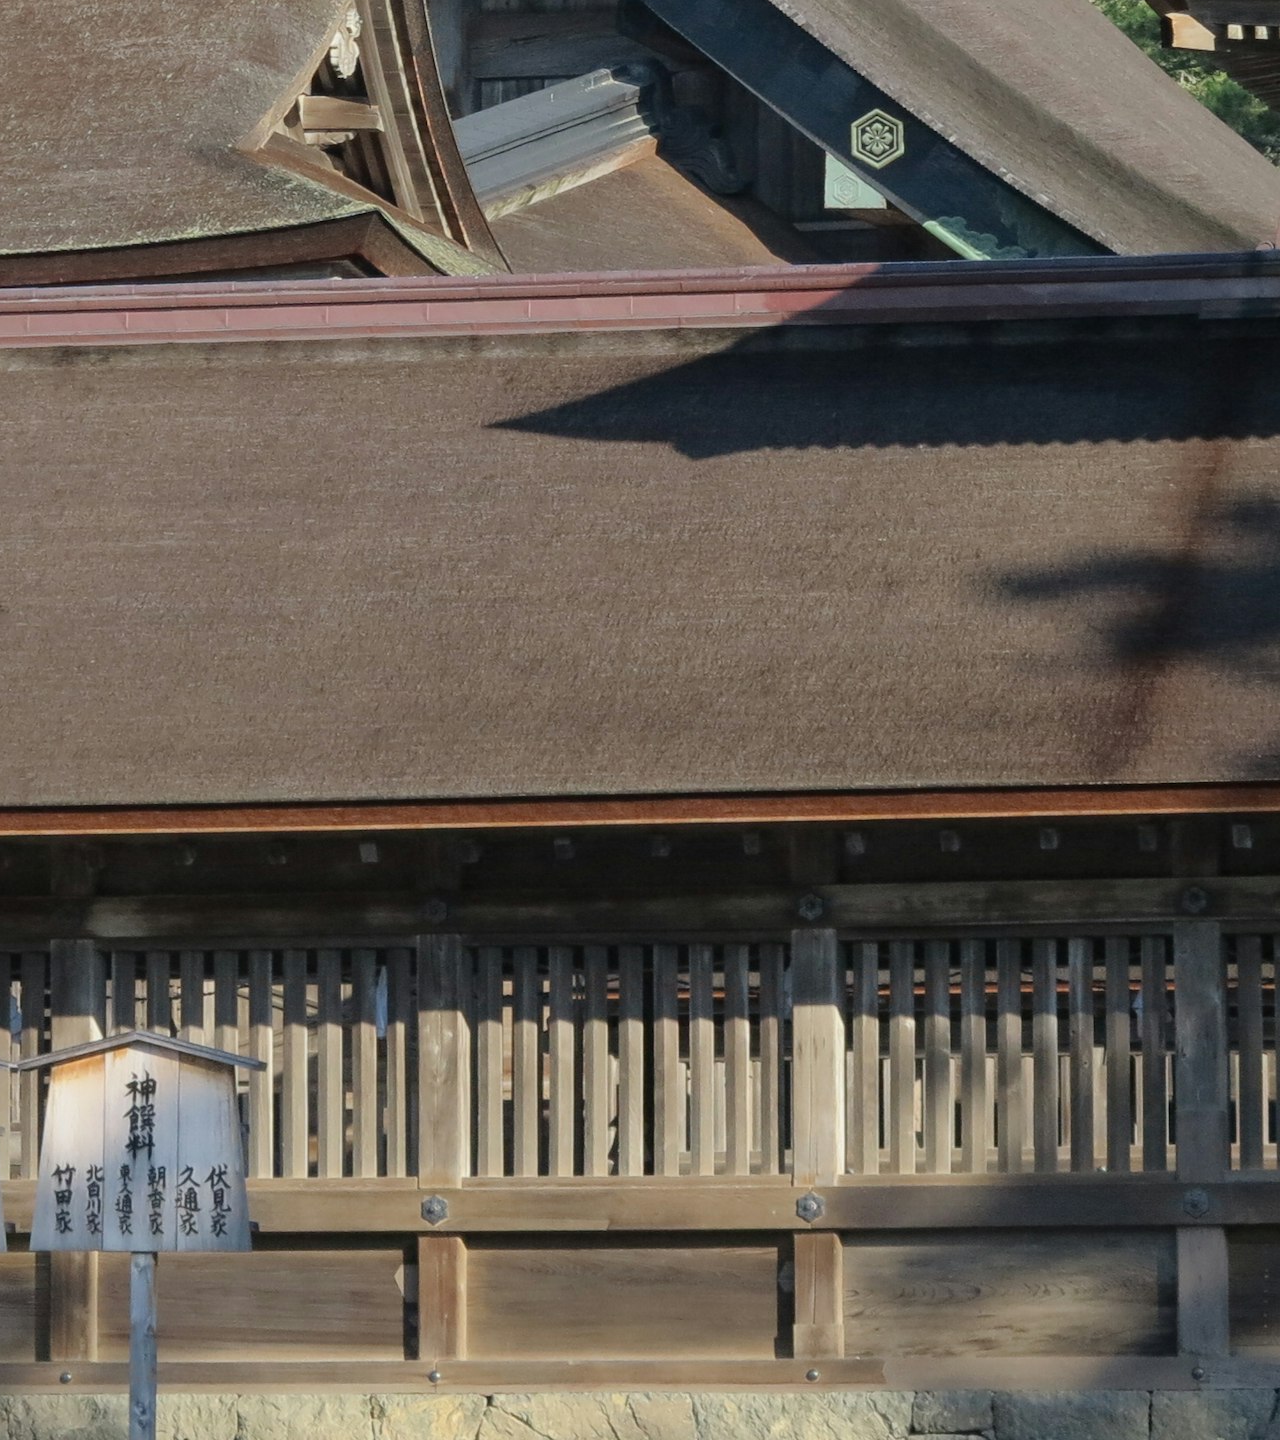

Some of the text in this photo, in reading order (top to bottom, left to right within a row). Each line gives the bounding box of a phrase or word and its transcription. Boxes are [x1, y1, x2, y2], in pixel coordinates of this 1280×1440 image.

[123, 1071, 157, 1160] 神饌料
[51, 1163, 76, 1234] 竹田家
[86, 1164, 104, 1235] 北白川家
[147, 1164, 166, 1235] 朝香家
[205, 1163, 232, 1238] 伏見家
